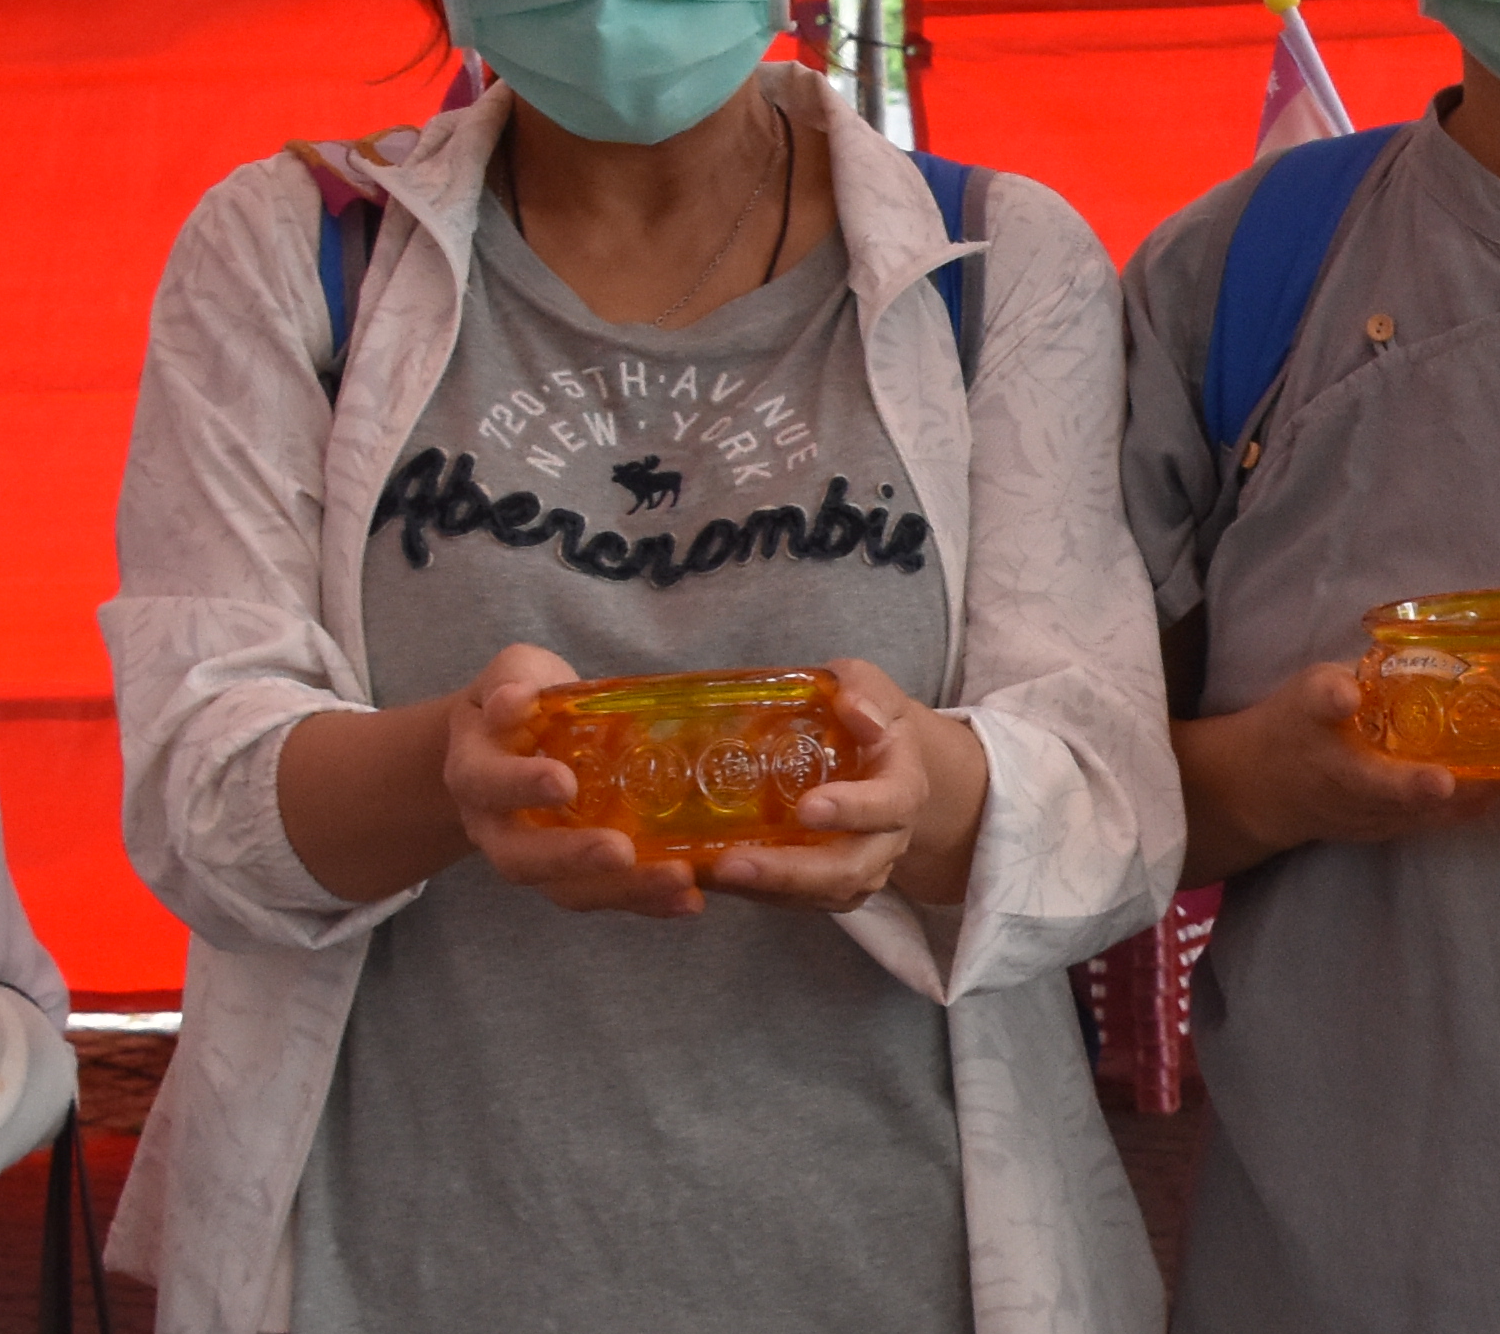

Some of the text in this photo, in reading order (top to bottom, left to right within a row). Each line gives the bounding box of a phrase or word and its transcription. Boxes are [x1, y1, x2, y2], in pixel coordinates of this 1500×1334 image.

[477, 360, 819, 472] 720 5TH AVNUE
[525, 410, 774, 487] NEW YORK
[367, 446, 932, 589] Abercrombie
